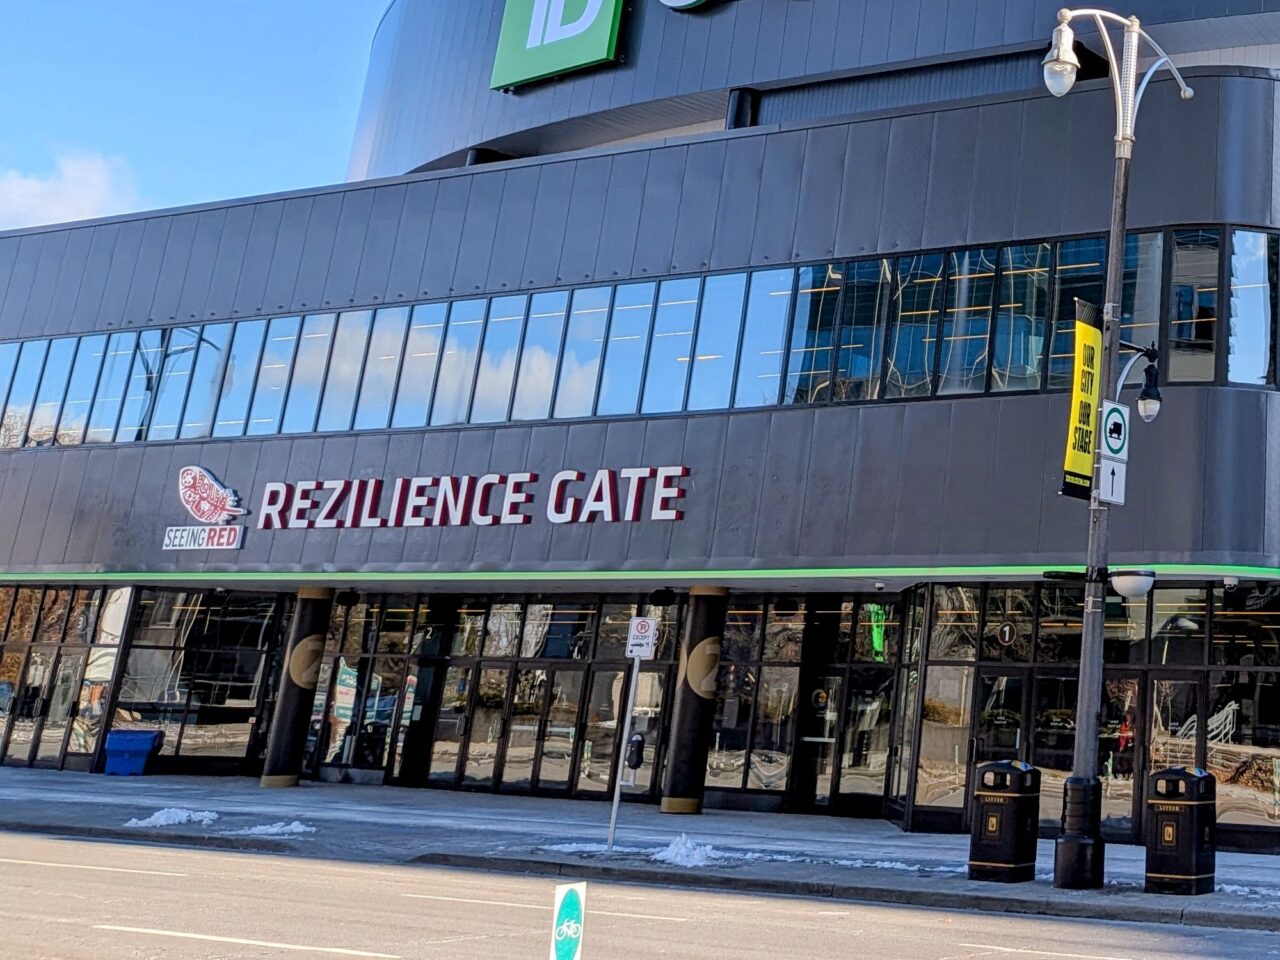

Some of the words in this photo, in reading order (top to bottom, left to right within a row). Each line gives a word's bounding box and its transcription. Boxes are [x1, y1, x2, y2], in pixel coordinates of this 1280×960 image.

[1082, 343, 1095, 371] OUR
[1080, 368, 1095, 396] CITY
[1078, 399, 1091, 428] OUR
[1072, 425, 1093, 455] STAGE
[257, 472, 539, 529] REZILIENCE
[546, 465, 691, 524] GATE
[425, 626, 433, 640] 2
[1002, 625, 1010, 642] 1
